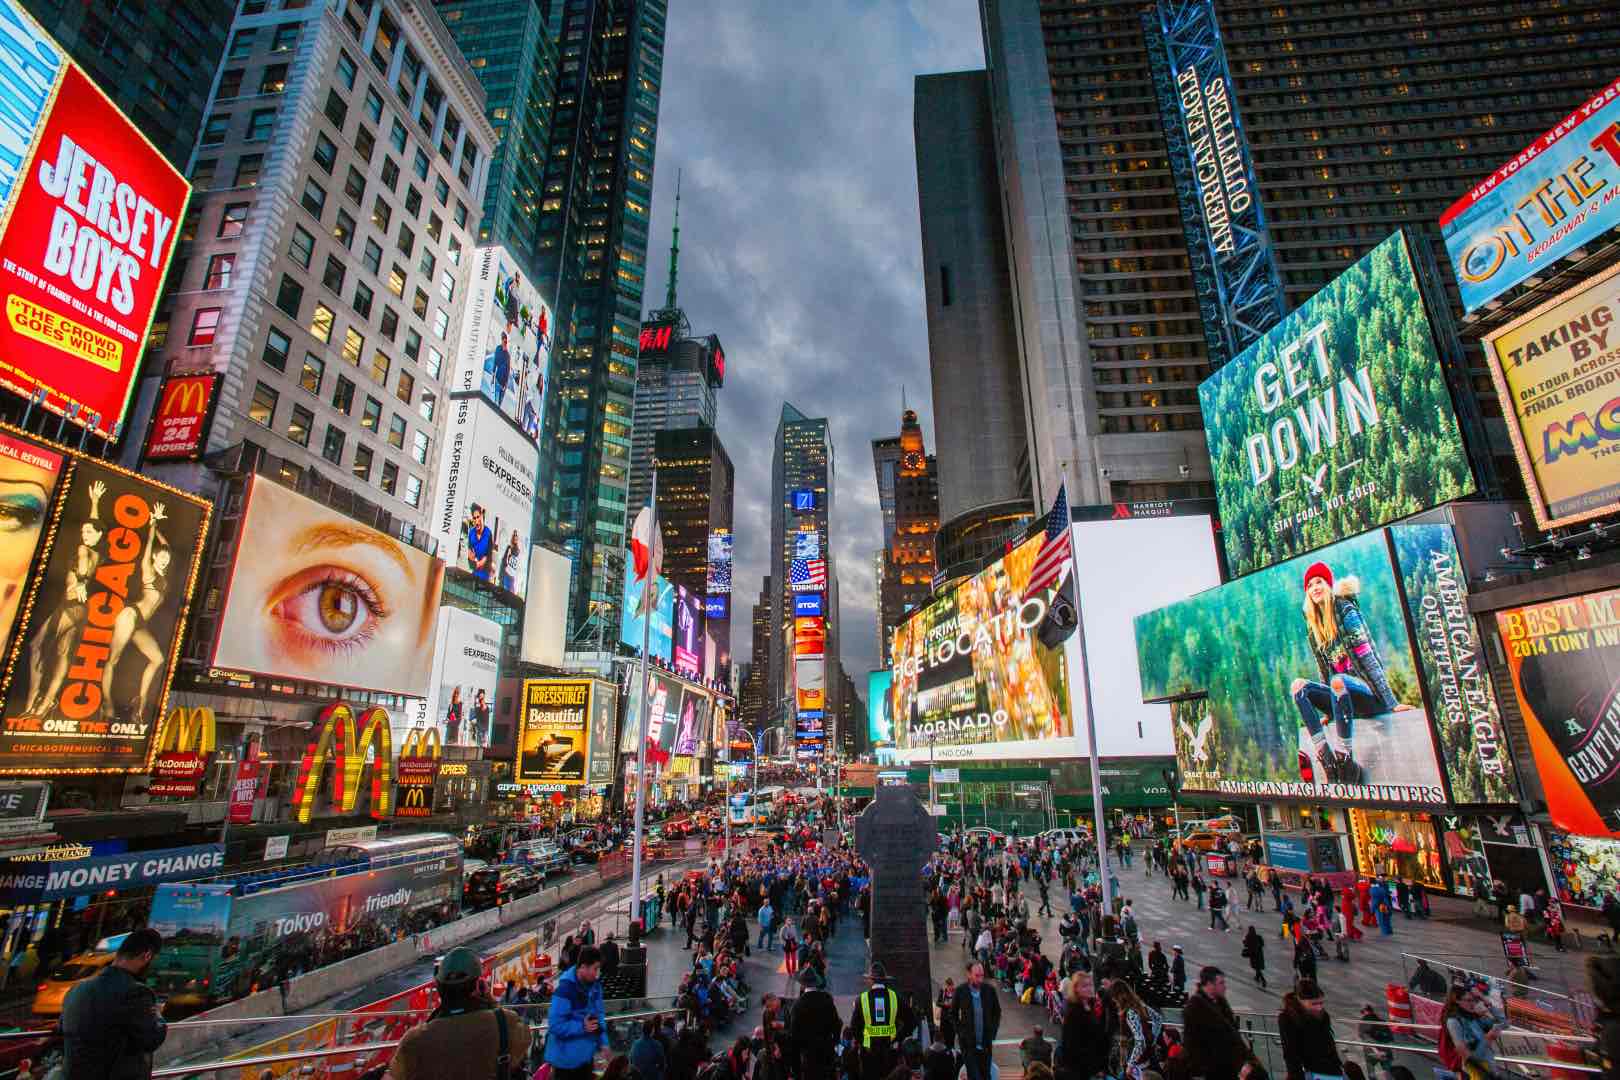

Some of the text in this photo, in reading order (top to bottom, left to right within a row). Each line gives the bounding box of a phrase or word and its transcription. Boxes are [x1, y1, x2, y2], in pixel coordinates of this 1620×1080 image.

[1177, 65, 1234, 252] AMERICAN EAGLE
[1205, 77, 1251, 213] OUTFITTERS
[1472, 178, 1497, 201] NEW
[1500, 145, 1542, 179] YORK,
[1545, 115, 1577, 144] NEW
[38, 133, 173, 269] JERSEY
[1460, 156, 1608, 283] ON THE
[3, 258, 16, 273] THE
[16, 266, 39, 285] STORY
[43, 206, 141, 315] BOYS
[15, 314, 64, 341] GOES
[60, 320, 117, 352] CROWD
[1508, 305, 1614, 368] TAKING
[1569, 327, 1609, 362] BY
[1254, 321, 1332, 414] GET
[1520, 388, 1536, 401] ON
[1539, 371, 1569, 392] TOUR
[163, 416, 197, 426] OPEN
[1525, 397, 1563, 417] FINAL
[163, 428, 190, 440] 24
[1246, 366, 1379, 487] DOWN
[20, 451, 53, 470] REVIVAL
[152, 444, 195, 452] HOURS
[441, 432, 464, 535] @EXPRESSRUNWAY
[1134, 508, 1171, 516] MARQUIS
[1273, 514, 1295, 533] STAY
[1327, 495, 1345, 510] NOT
[1349, 483, 1377, 502] COLD
[60, 494, 150, 719] CHICAGO
[1506, 600, 1580, 641] BEST
[1511, 625, 1620, 657] 2014 TONY AW
[1422, 595, 1465, 724] OUTFITTERS
[1431, 550, 1504, 775] AMERICAN EAGLE
[7, 719, 148, 735] THE ONE THE ONLY
[529, 709, 584, 723] Beautiful
[914, 709, 1008, 737] VORNADO
[1565, 718, 1586, 736] A
[527, 784, 567, 792] LUGGAGE
[1219, 780, 1444, 804] AMERICAN EAGLE OUTFITTERS
[10, 847, 93, 862] MONEY EXCHANGE
[45, 861, 137, 891] MONEY
[143, 851, 224, 876] CHANGE
[276, 888, 412, 937] Tokyo friendly
